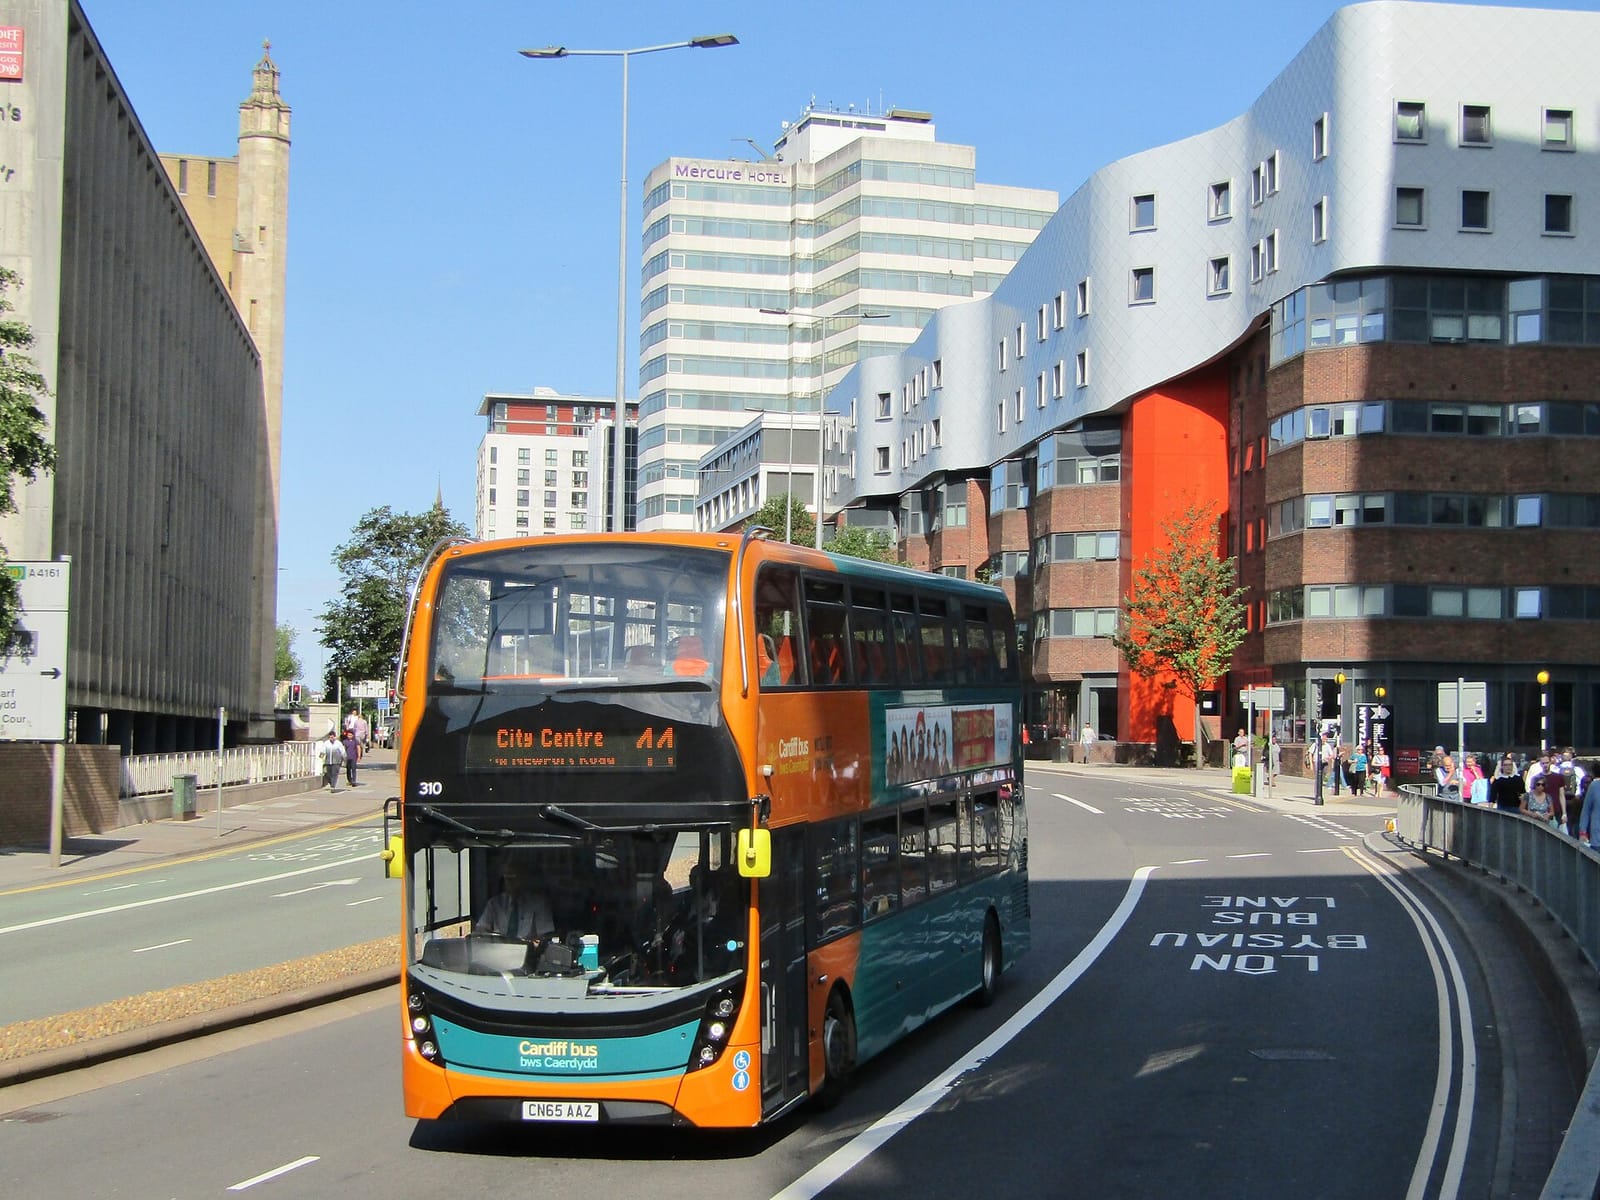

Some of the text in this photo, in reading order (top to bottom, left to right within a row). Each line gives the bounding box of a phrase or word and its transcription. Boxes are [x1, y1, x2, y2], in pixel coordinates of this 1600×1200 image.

[675, 164, 787, 184] Mercure HOTEL
[0, 688, 16, 698] arf
[2, 714, 27, 724] Cour
[496, 728, 533, 748] City
[541, 728, 604, 748] Centre
[419, 781, 443, 796] 310
[1200, 895, 1336, 908] LANE
[1212, 911, 1318, 925] BUS
[1149, 932, 1368, 949] BYSIAU
[519, 1041, 598, 1056] Cardiff bus
[520, 1056, 598, 1070] bws Caerdydd
[528, 1103, 592, 1118] CN65 AAZ
